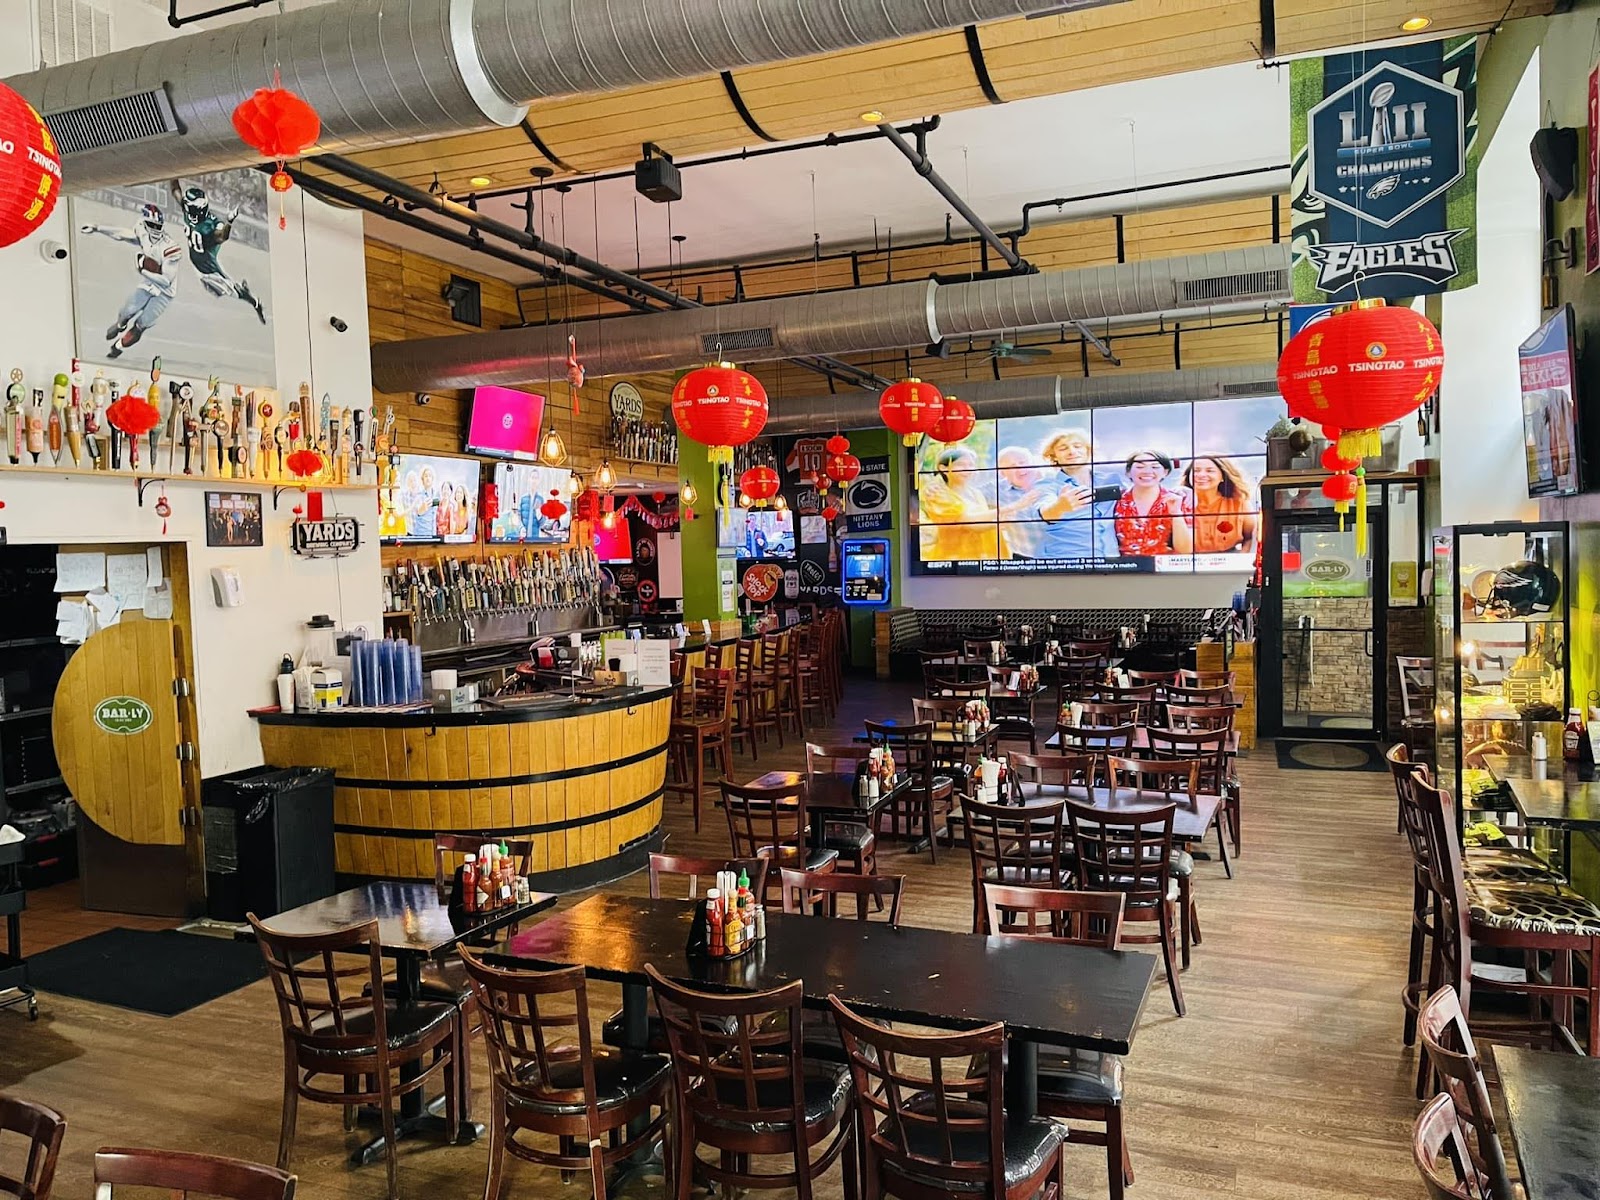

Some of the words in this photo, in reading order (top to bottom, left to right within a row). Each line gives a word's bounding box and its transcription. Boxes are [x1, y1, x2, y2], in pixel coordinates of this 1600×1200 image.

[1354, 147, 1384, 155] SUPER
[1388, 142, 1413, 151] BOWL
[1336, 156, 1432, 178] CHAMPIONS
[1315, 233, 1454, 285] EAGLES
[1293, 365, 1338, 379] TSINGTAO
[1348, 361, 1405, 372] TSINGTAO
[614, 394, 642, 414] YARDS
[697, 396, 730, 405] TSINGTAO
[866, 463, 886, 472] STATE
[853, 513, 884, 522] NITTANY
[857, 520, 880, 528] LIONS
[302, 523, 354, 541] YARDS
